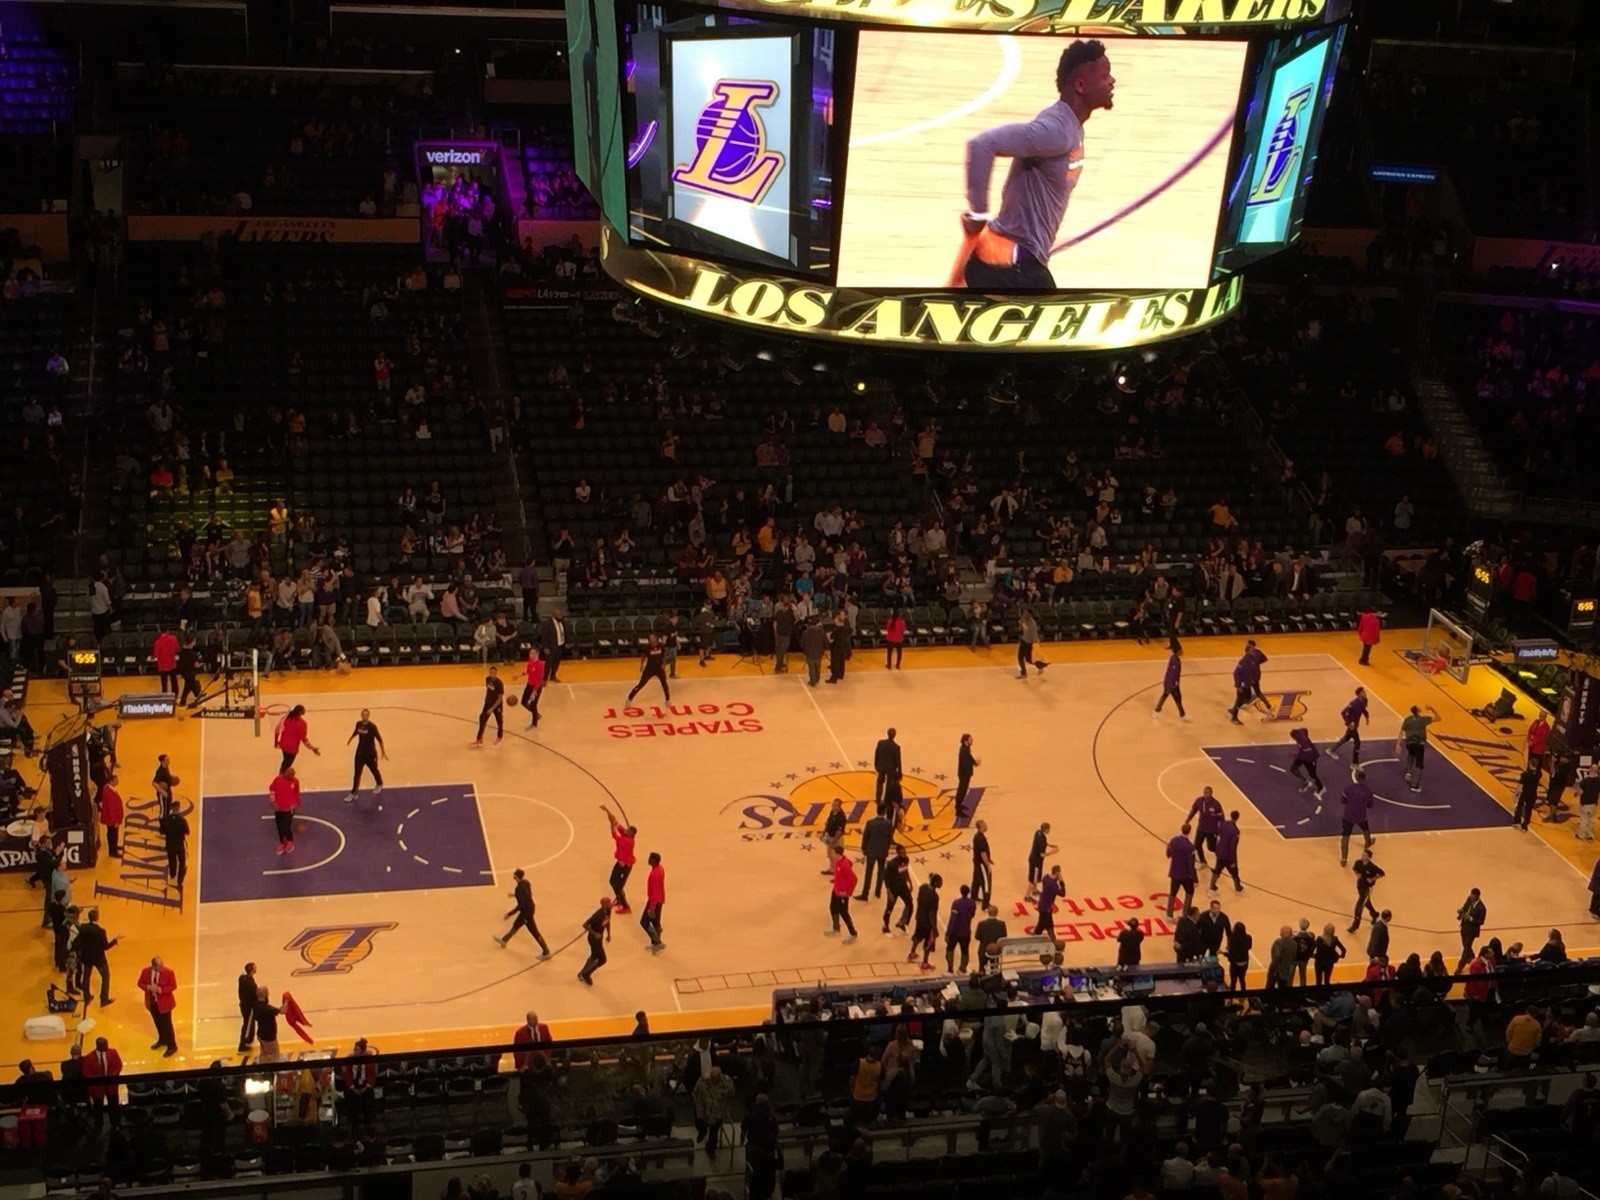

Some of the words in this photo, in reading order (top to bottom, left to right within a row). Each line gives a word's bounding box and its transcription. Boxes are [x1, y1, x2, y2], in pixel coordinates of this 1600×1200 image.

[426, 148, 481, 164] verizon
[685, 266, 833, 328] LOS
[838, 287, 1193, 344] ANGELES
[607, 719, 764, 739] STAPLES
